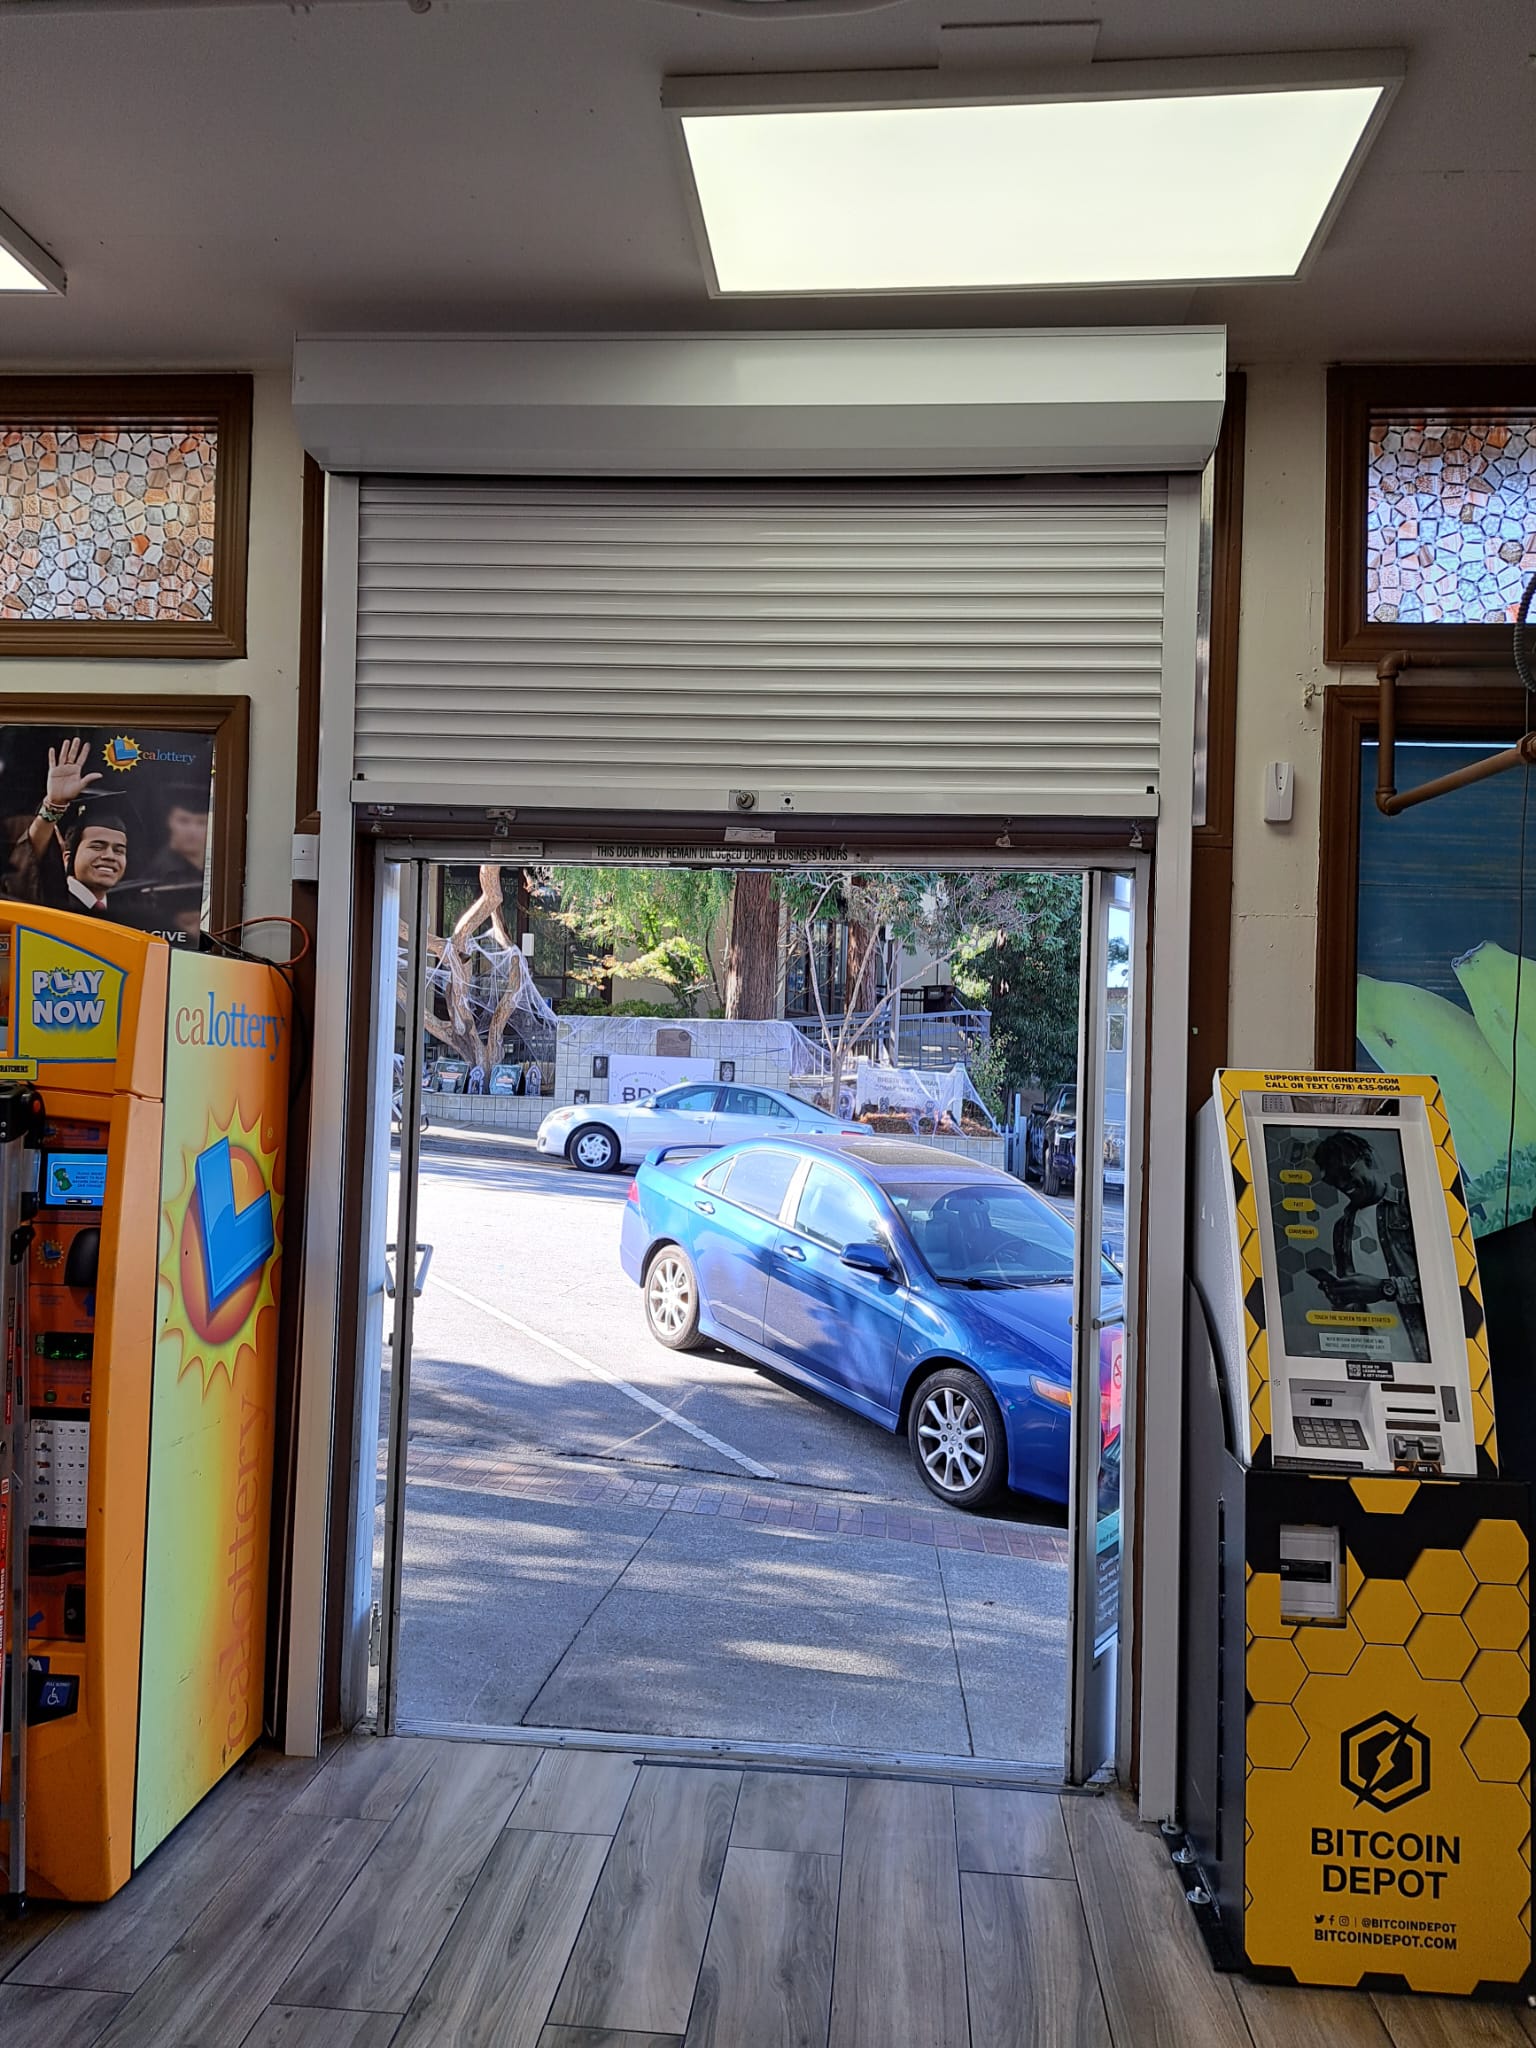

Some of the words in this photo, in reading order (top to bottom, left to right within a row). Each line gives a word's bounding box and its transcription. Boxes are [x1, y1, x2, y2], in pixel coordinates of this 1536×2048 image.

[142, 748, 193, 766] calottery
[597, 846, 615, 858] THIS
[617, 846, 640, 858] DOOR
[641, 847, 665, 858] MUST
[666, 847, 698, 859] REMAIN
[699, 847, 742, 860] UNLOCKED
[744, 848, 776, 861] DURING
[777, 848, 817, 861] BUSINESS
[819, 849, 848, 861] HOURS
[32, 968, 105, 997] PLAY
[32, 999, 105, 1025] NOW
[174, 991, 285, 1063] calottery
[1263, 1074, 1400, 1084] SUPPORT@BITCOINDEPOT.COM
[1265, 1081, 1289, 1089] CALL
[1290, 1082, 1304, 1090] OR
[1306, 1082, 1329, 1090] TEXT
[1331, 1083, 1355, 1091] (678)
[1357, 1083, 1401, 1092] 435-9604
[218, 1392, 270, 1750] calottery
[1311, 1827, 1460, 1865] BITCOIN
[1322, 1864, 1448, 1899] DEPOT
[1361, 1917, 1457, 1933] @BITCOINDEPOT
[1314, 1928, 1457, 1950] BITCOINDEPOT.COM
